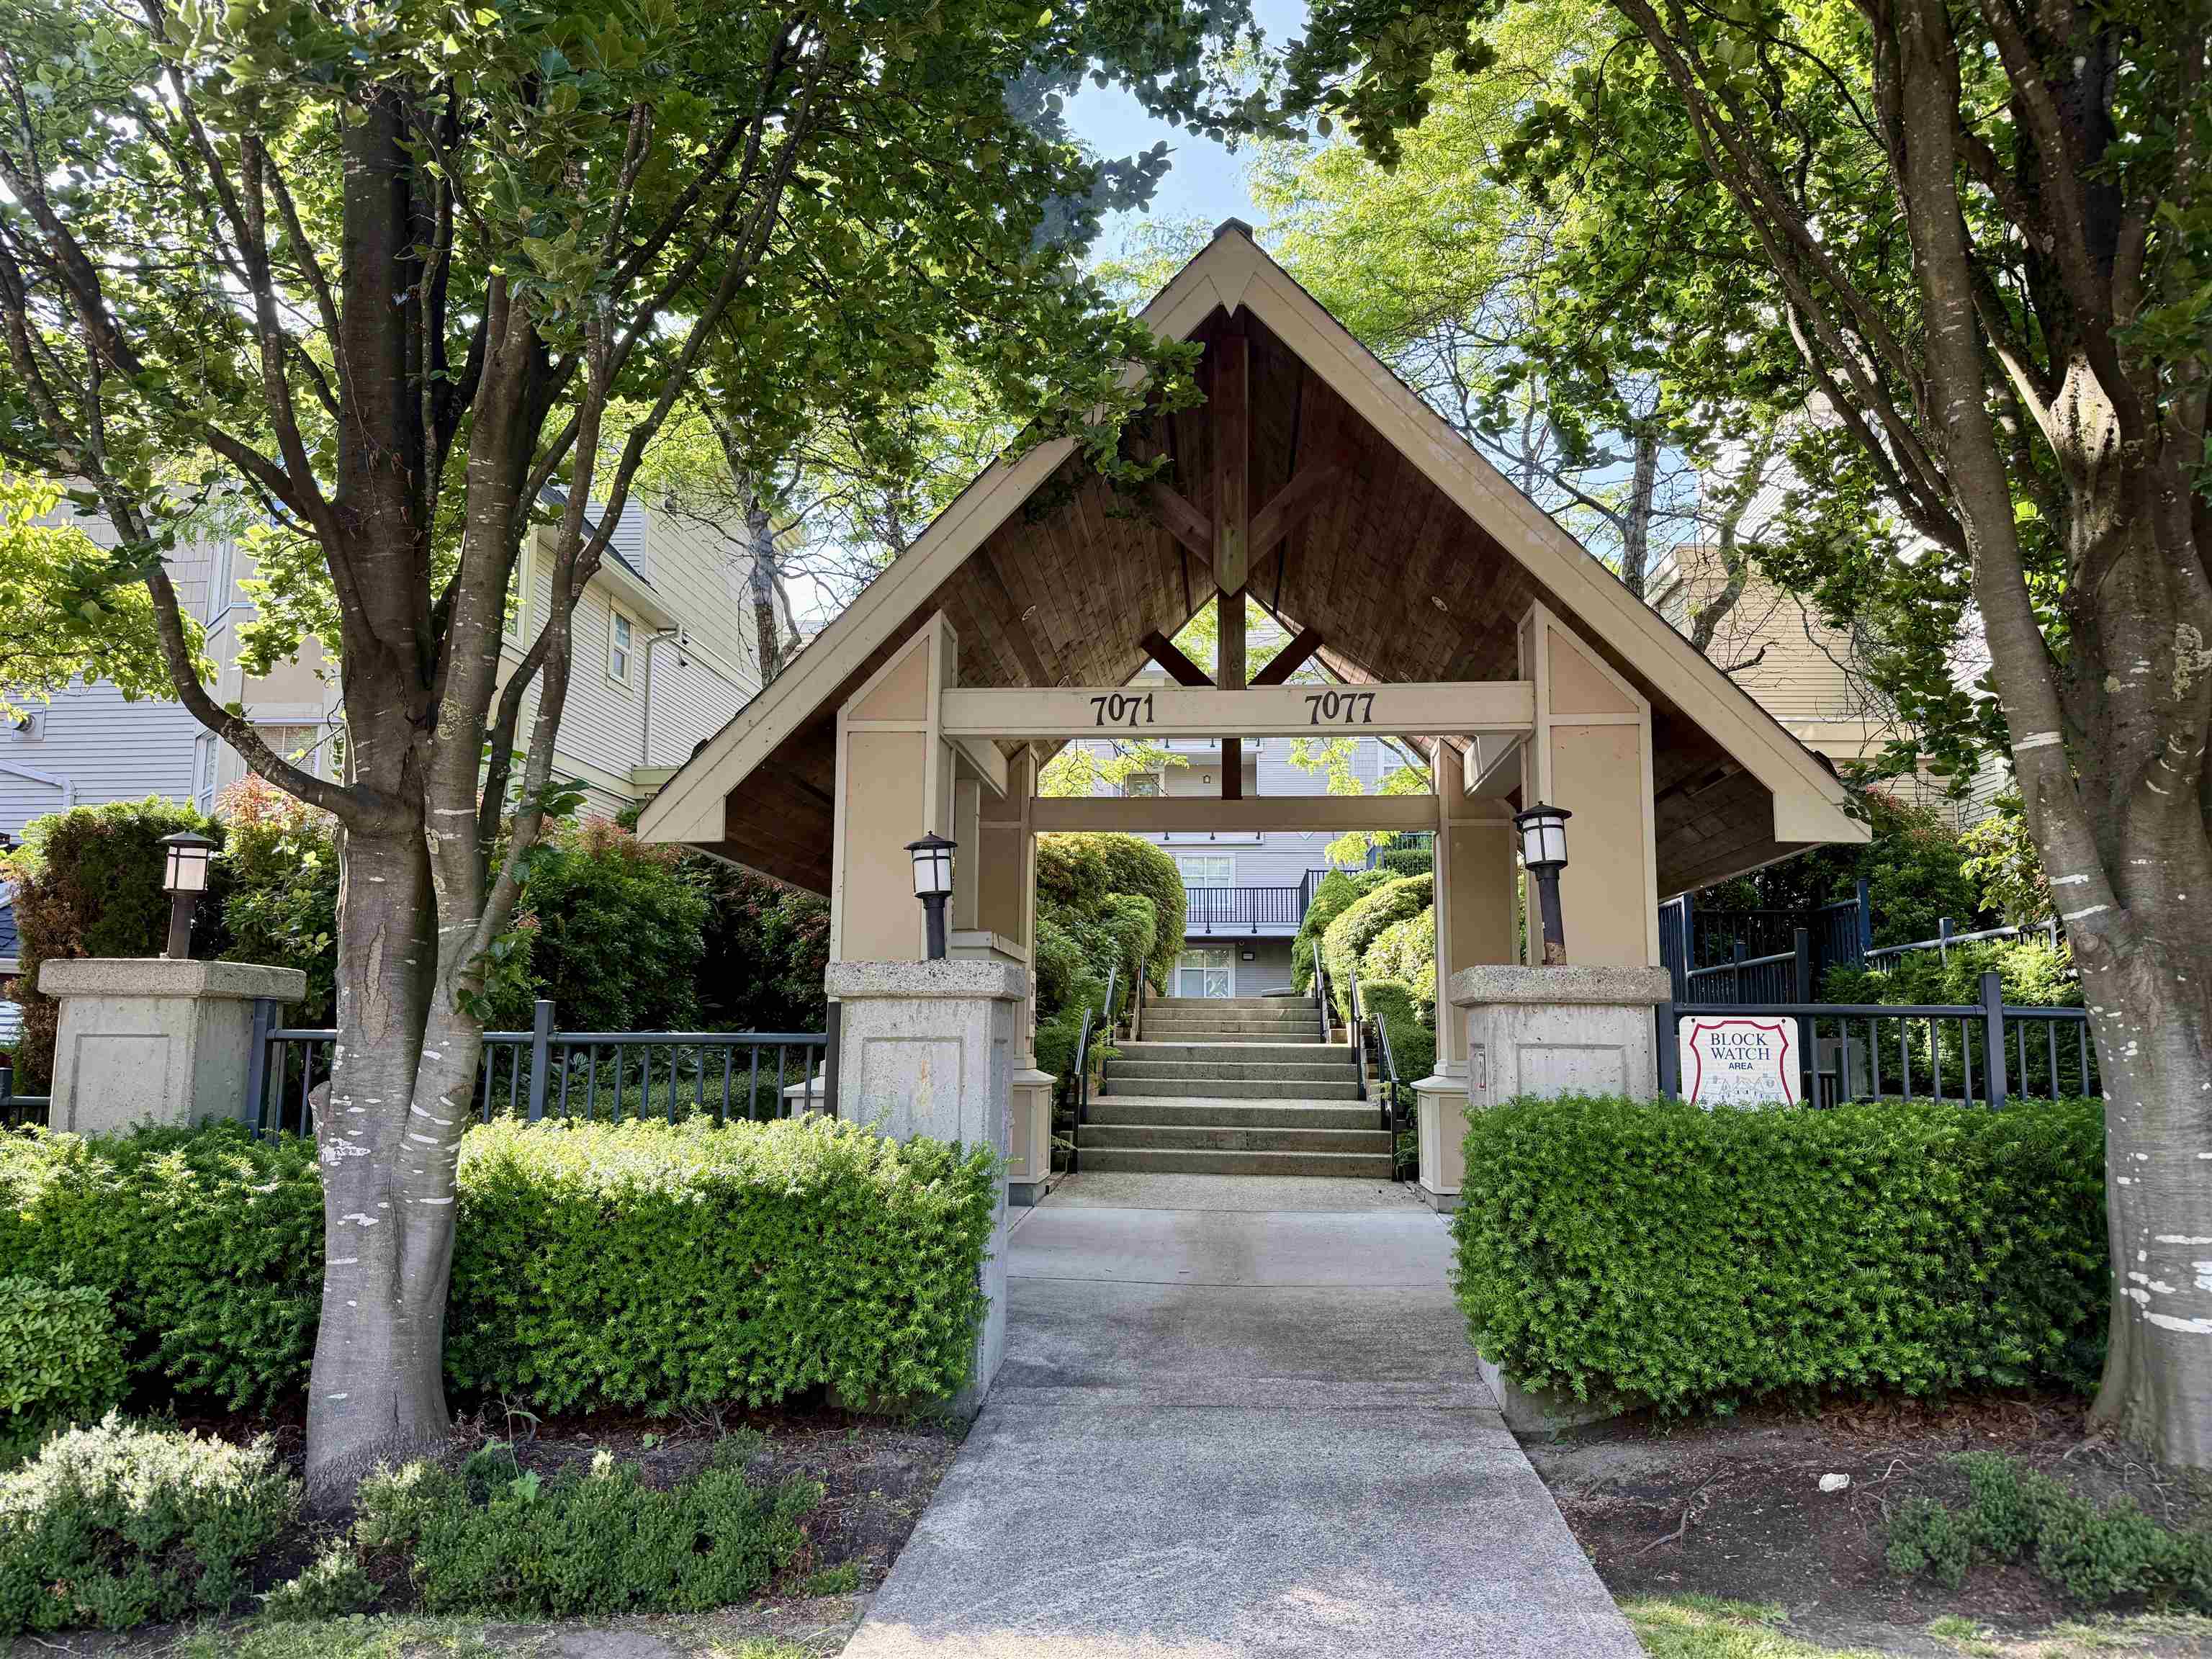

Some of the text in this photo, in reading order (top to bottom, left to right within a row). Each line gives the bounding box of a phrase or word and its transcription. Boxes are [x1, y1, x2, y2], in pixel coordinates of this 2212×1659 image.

[1090, 693, 1155, 726] 7071
[1305, 691, 1376, 724] 7077
[1711, 1033, 1768, 1046] BLOCK
[1711, 1048, 1771, 1060] WATCH
